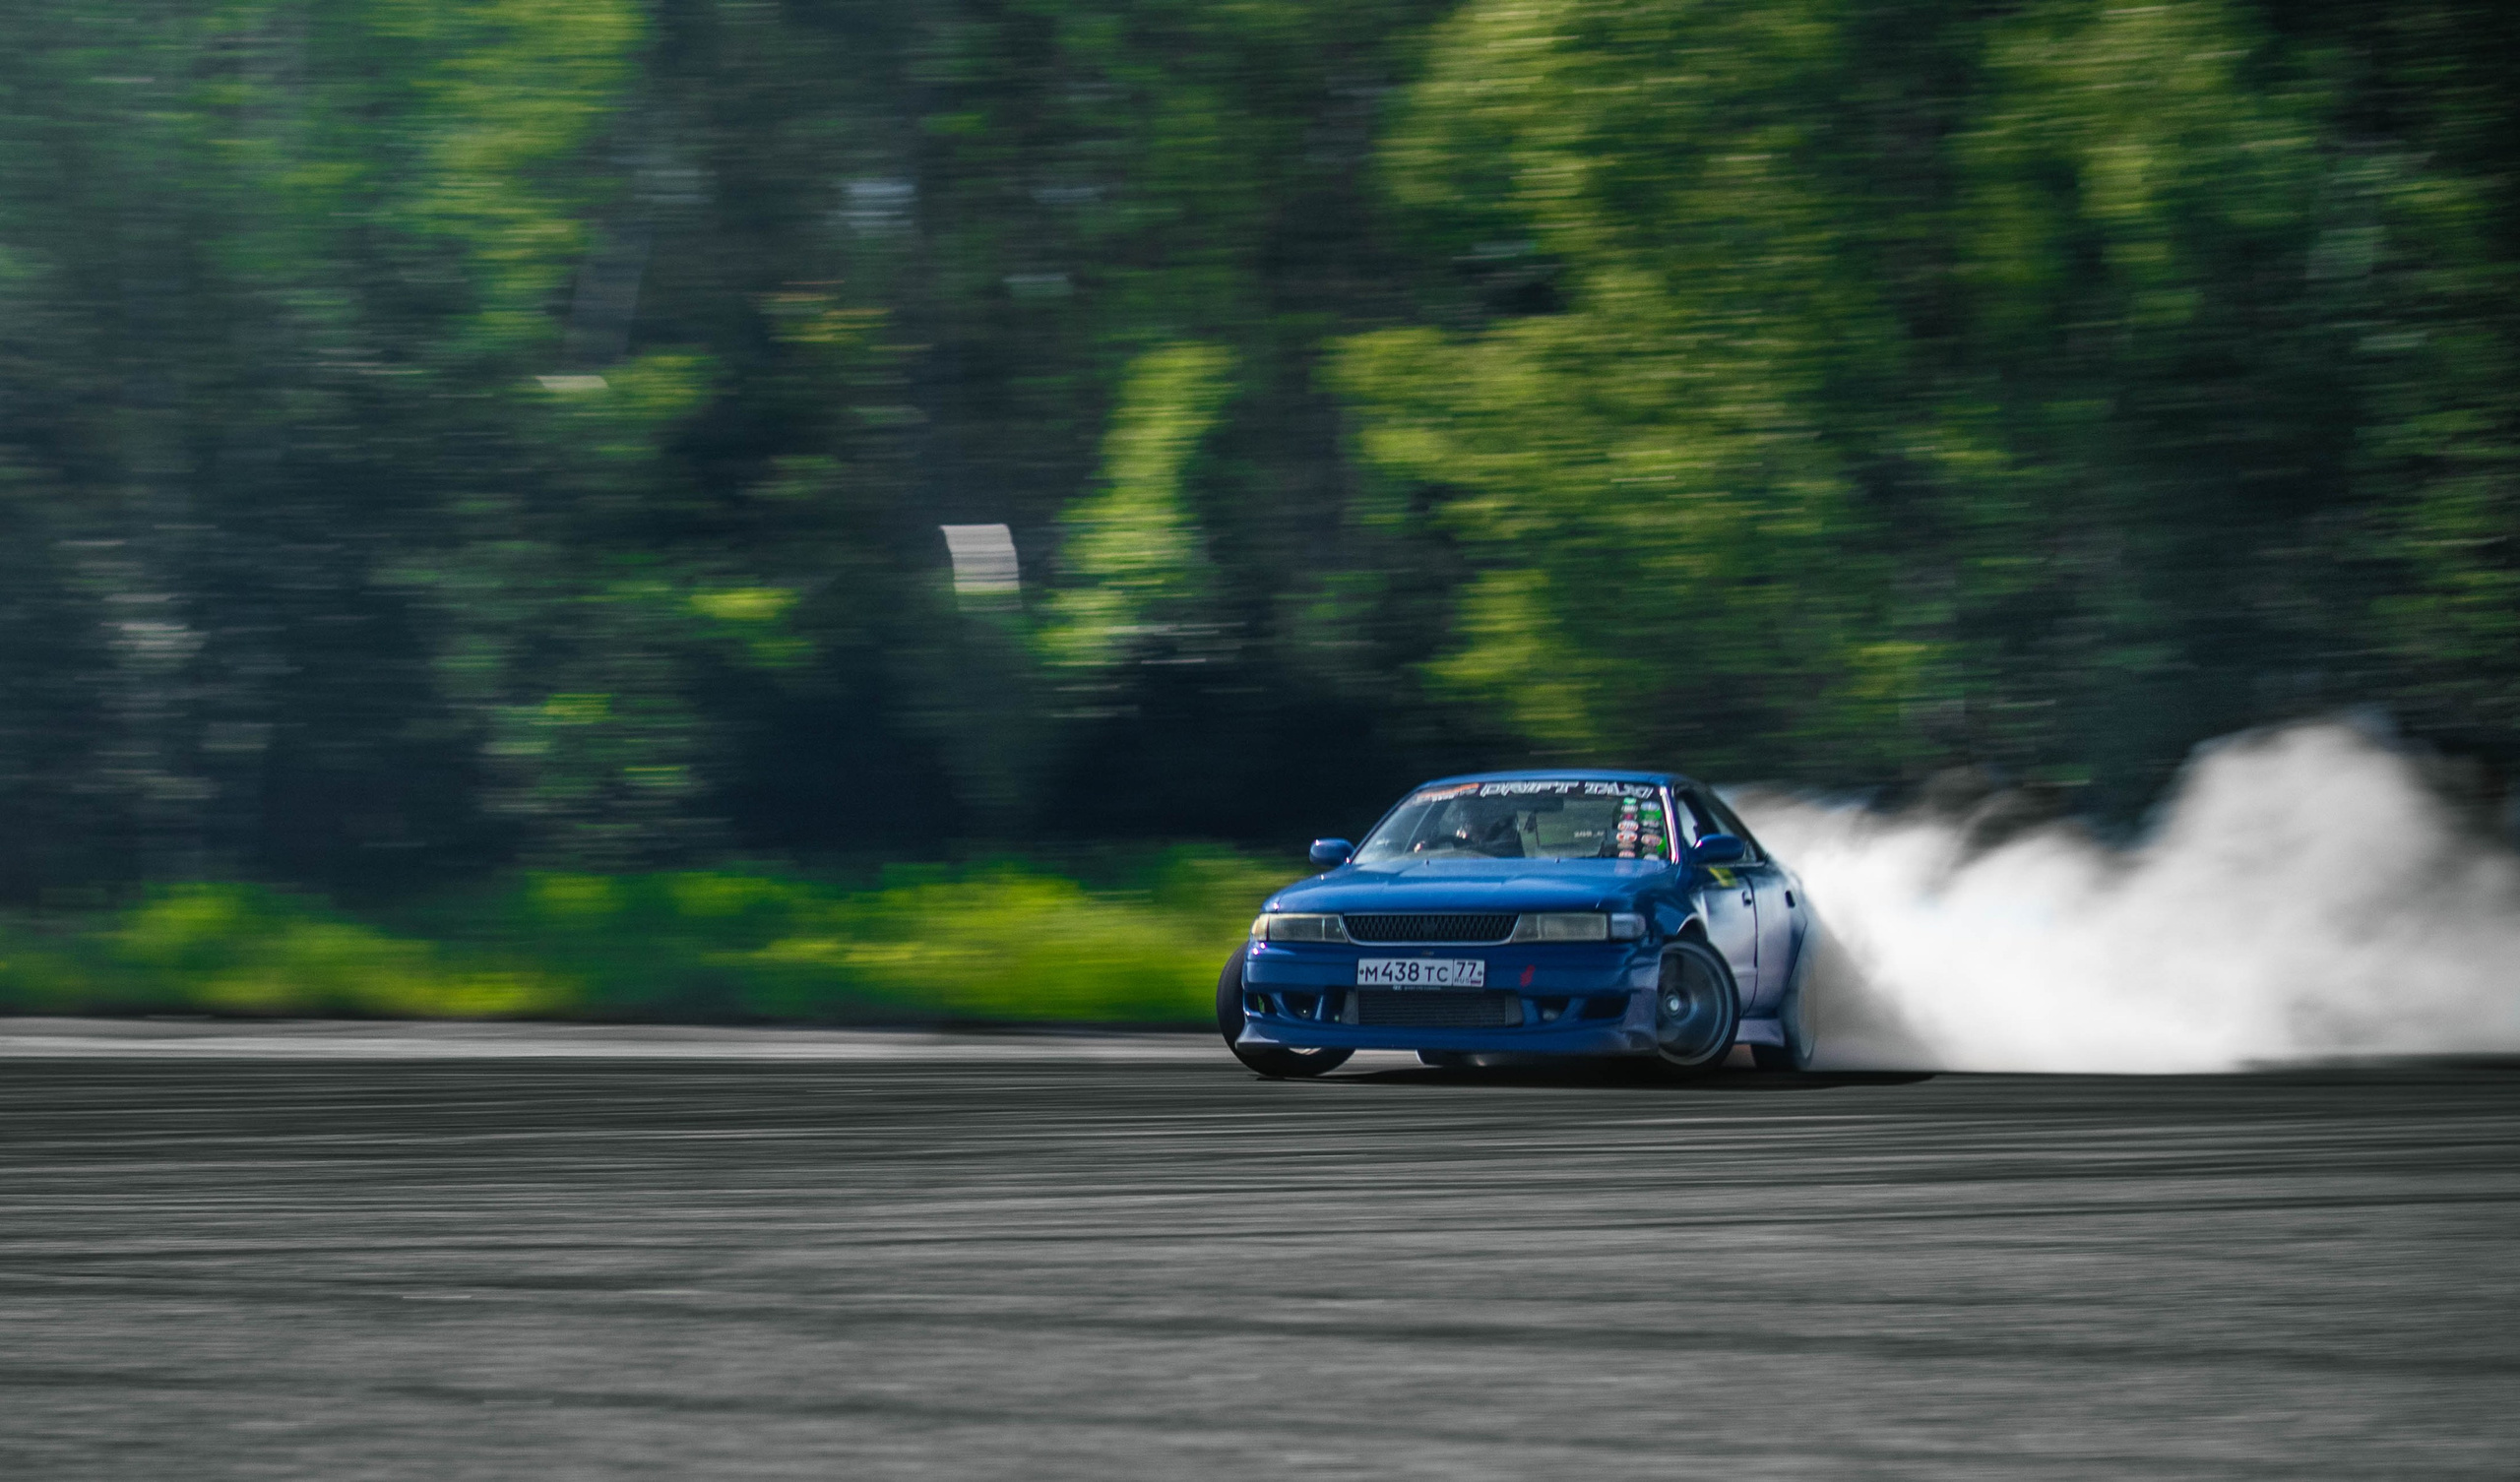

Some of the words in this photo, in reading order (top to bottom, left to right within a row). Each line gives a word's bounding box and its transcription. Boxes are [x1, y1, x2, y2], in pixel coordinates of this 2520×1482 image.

[1480, 781, 1579, 797] DRIFT
[1585, 781, 1655, 799] TAXI
[1457, 961, 1477, 977] 77
